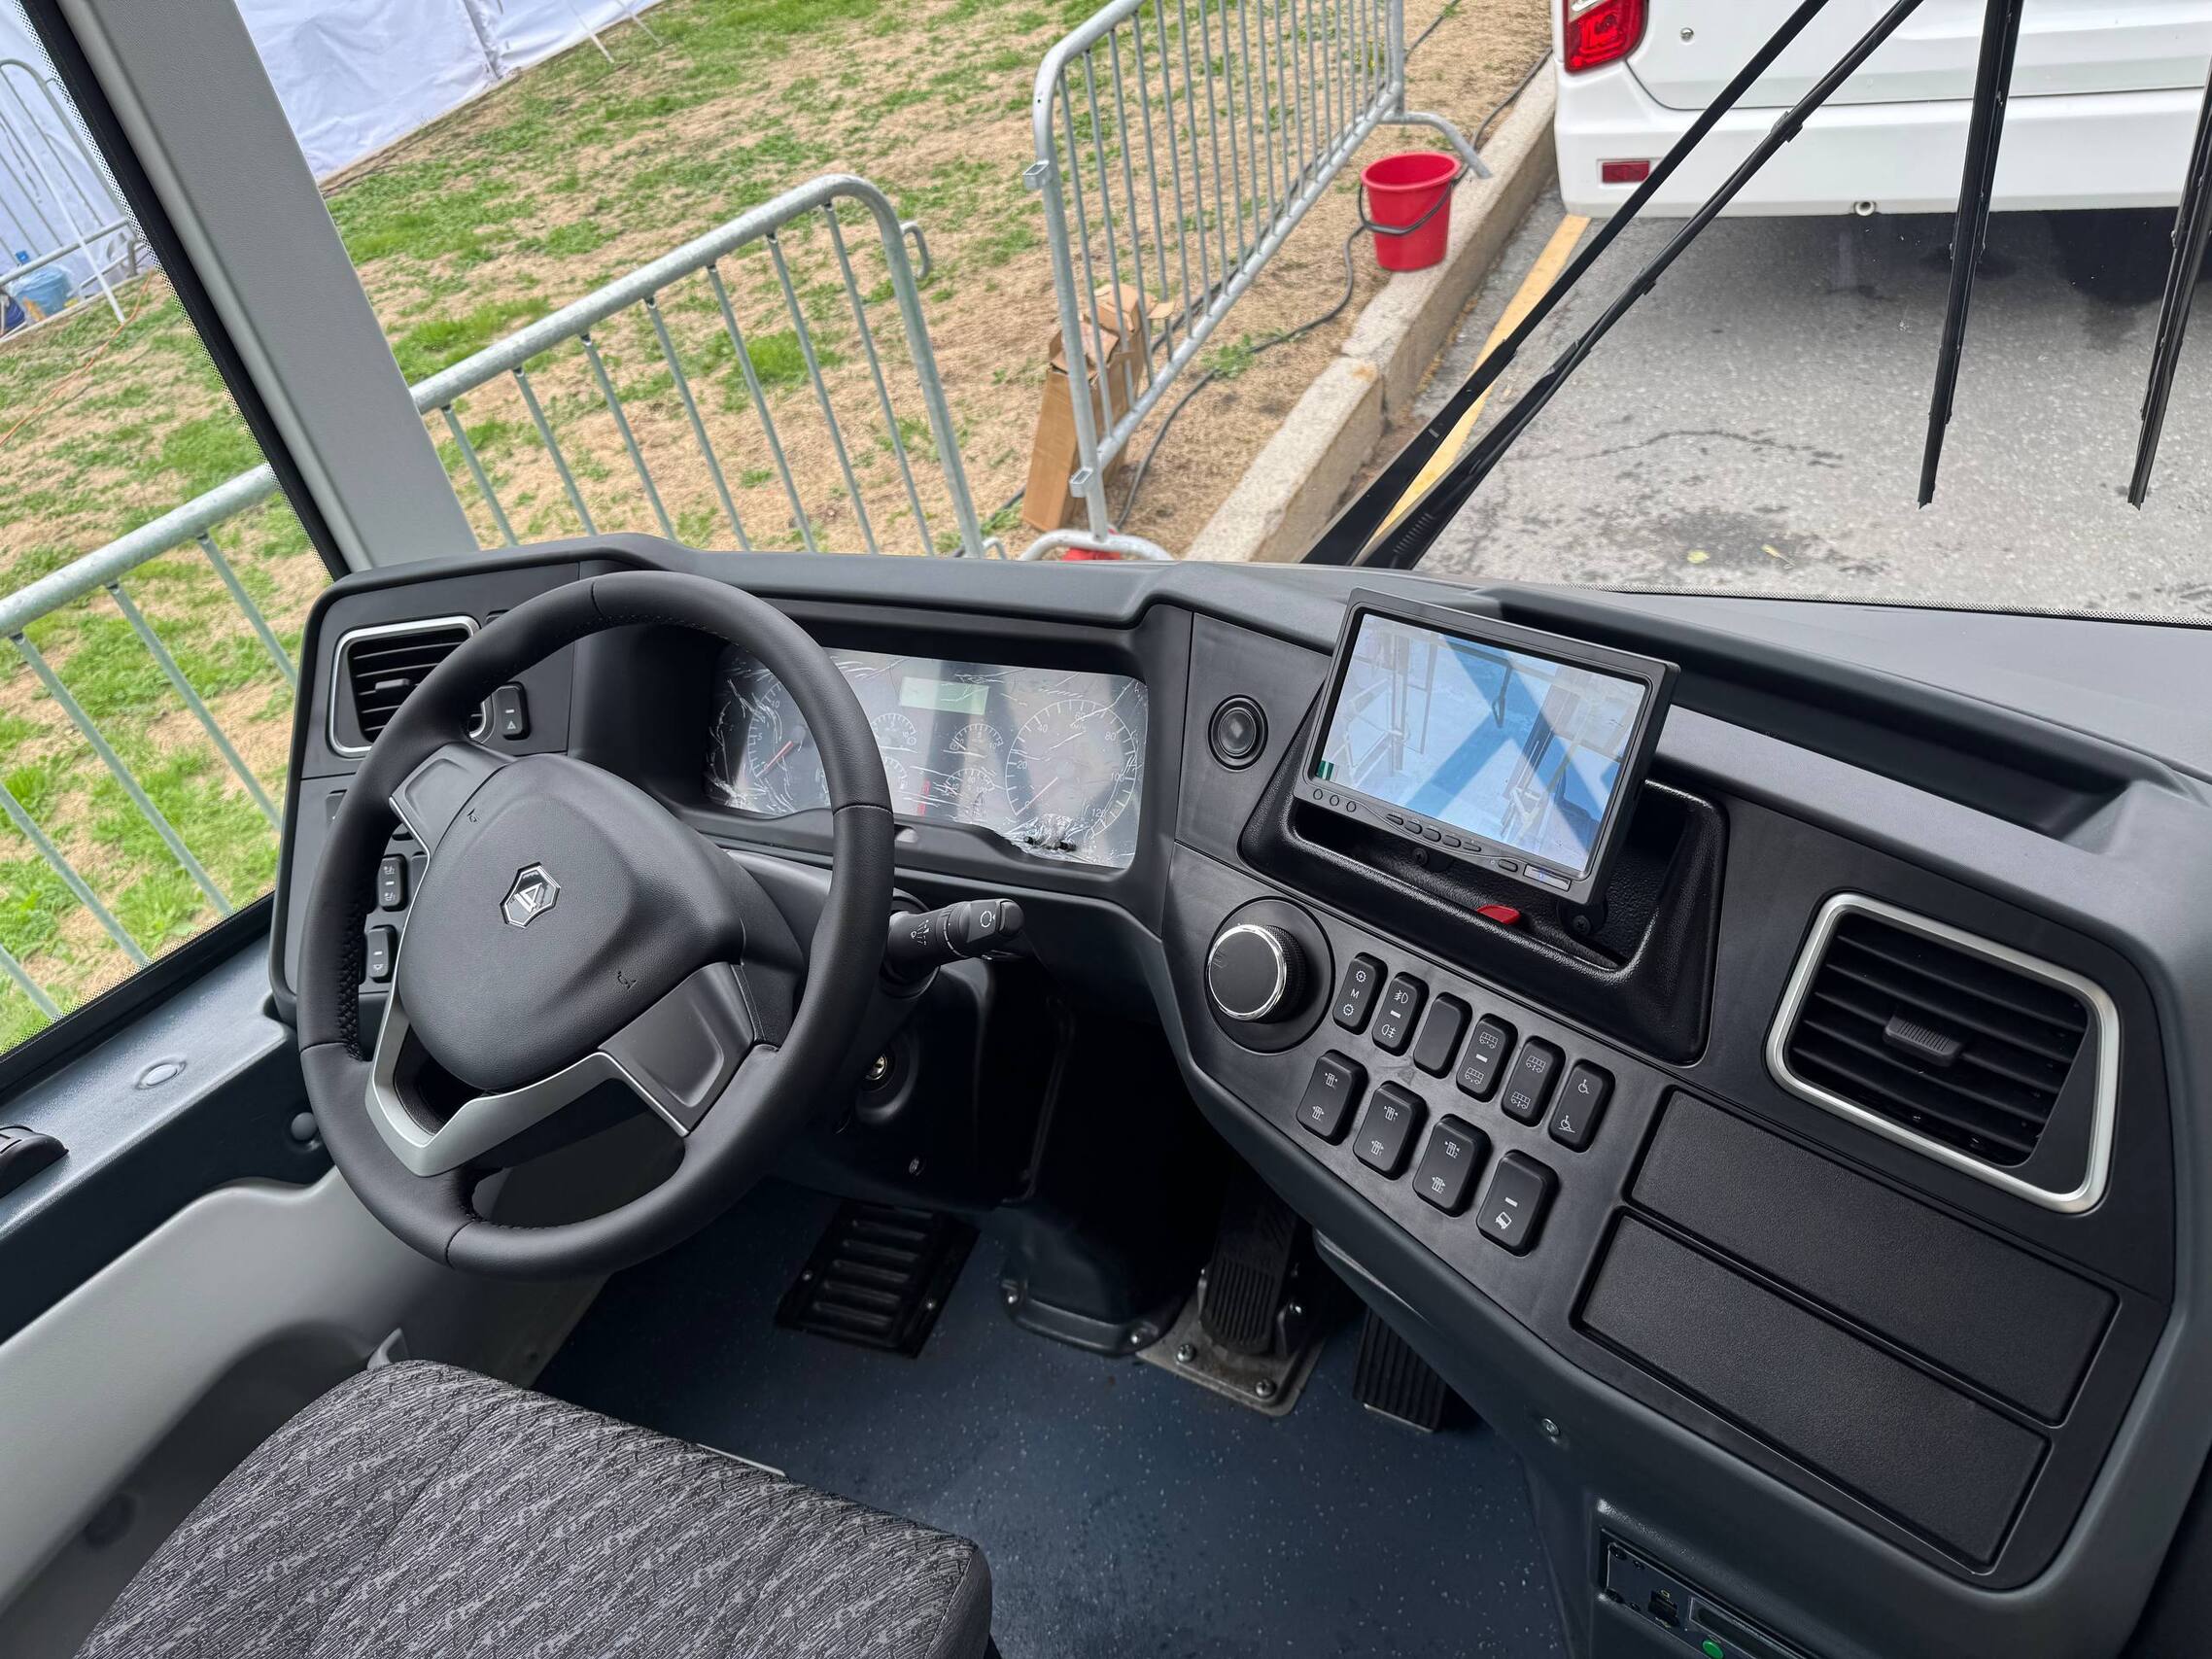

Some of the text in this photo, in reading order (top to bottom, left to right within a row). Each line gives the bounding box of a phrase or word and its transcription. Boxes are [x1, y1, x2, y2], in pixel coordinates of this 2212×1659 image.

[1105, 731, 1117, 742] 80
[1017, 761, 1028, 770] 20
[1111, 771, 1125, 782] 100
[1351, 987, 1360, 999] M
